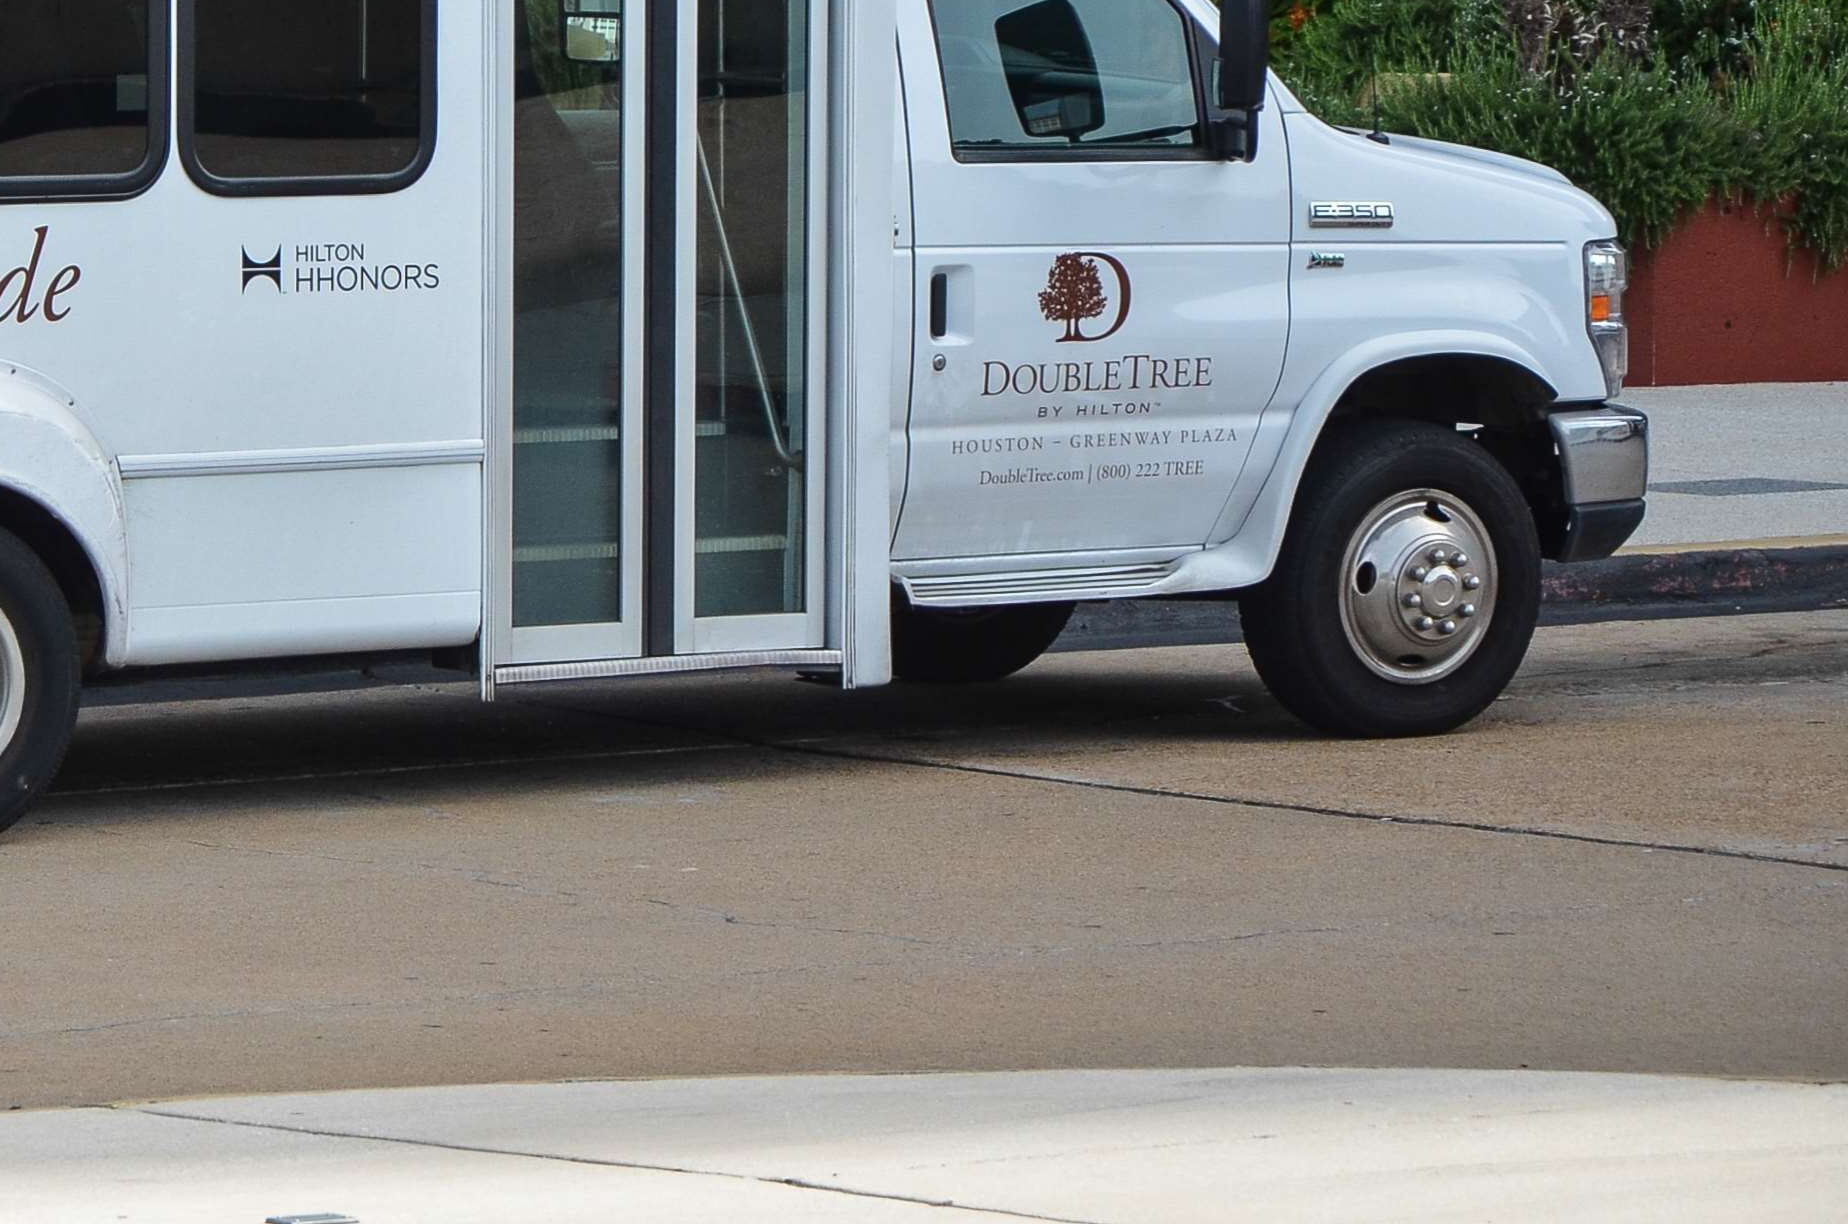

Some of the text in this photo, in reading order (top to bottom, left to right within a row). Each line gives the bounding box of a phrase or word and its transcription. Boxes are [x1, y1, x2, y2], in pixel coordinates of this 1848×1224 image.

[295, 243, 365, 262] HILTON
[295, 264, 439, 292] HHONORS
[1037, 405, 1063, 418] BY
[951, 436, 1044, 455] HOUSTON
[1070, 430, 1172, 449] GREENWAY
[1180, 428, 1238, 444] PLAZA
[979, 466, 1084, 485] DoubleTree.com
[1096, 463, 1131, 481] (800)
[1135, 463, 1160, 478] 222
[1164, 460, 1205, 477] TREE
